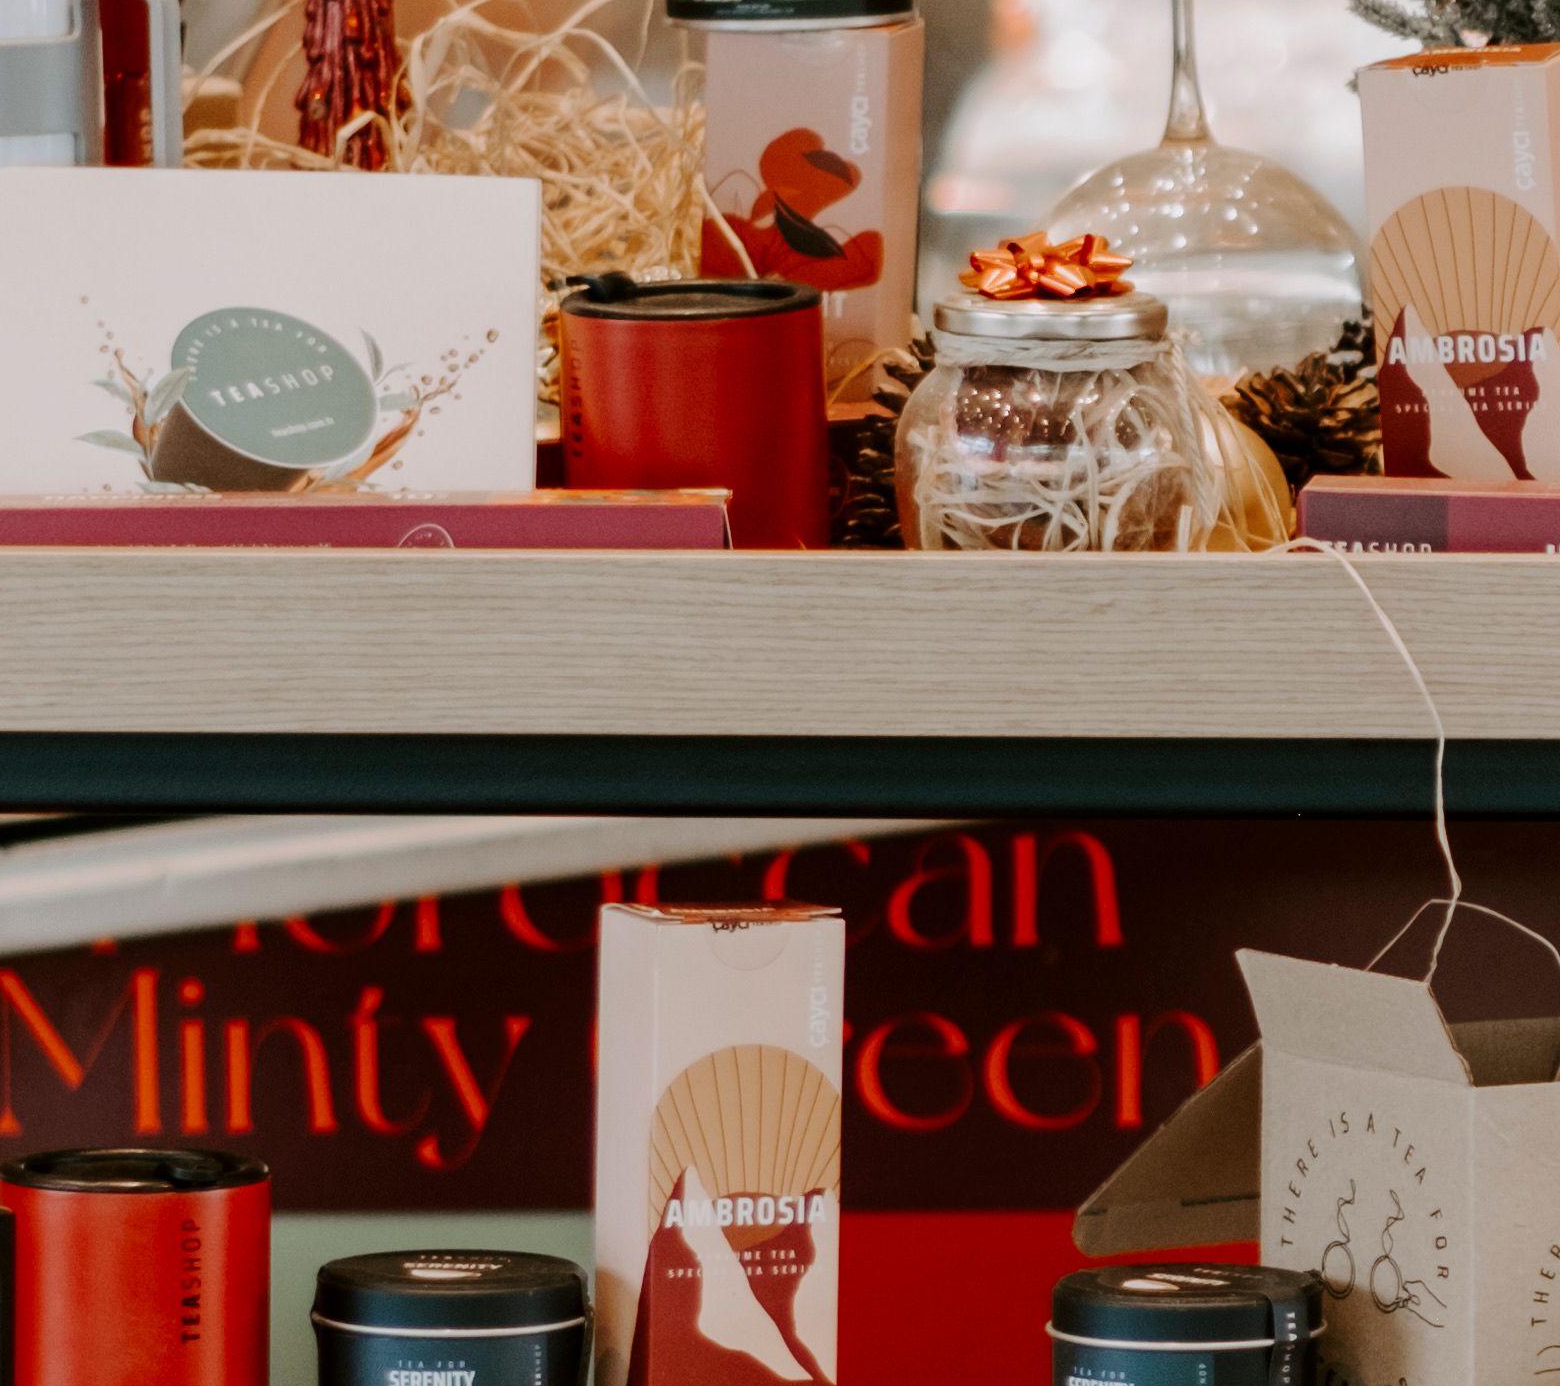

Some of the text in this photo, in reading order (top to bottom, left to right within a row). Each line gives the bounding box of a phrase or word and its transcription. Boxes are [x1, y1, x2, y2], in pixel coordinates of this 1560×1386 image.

[1389, 332, 1548, 365] AMBROSIA
[208, 364, 335, 408] TEASHOP
[1495, 386, 1521, 397] TEA
[844, 1011, 1224, 1133] een
[663, 1194, 828, 1230] AMBROSIA
[1280, 1111, 1451, 1281] THERE IS A TEA FOR
[770, 1249, 797, 1260] TEA
[181, 1217, 203, 1345] TEASHOP
